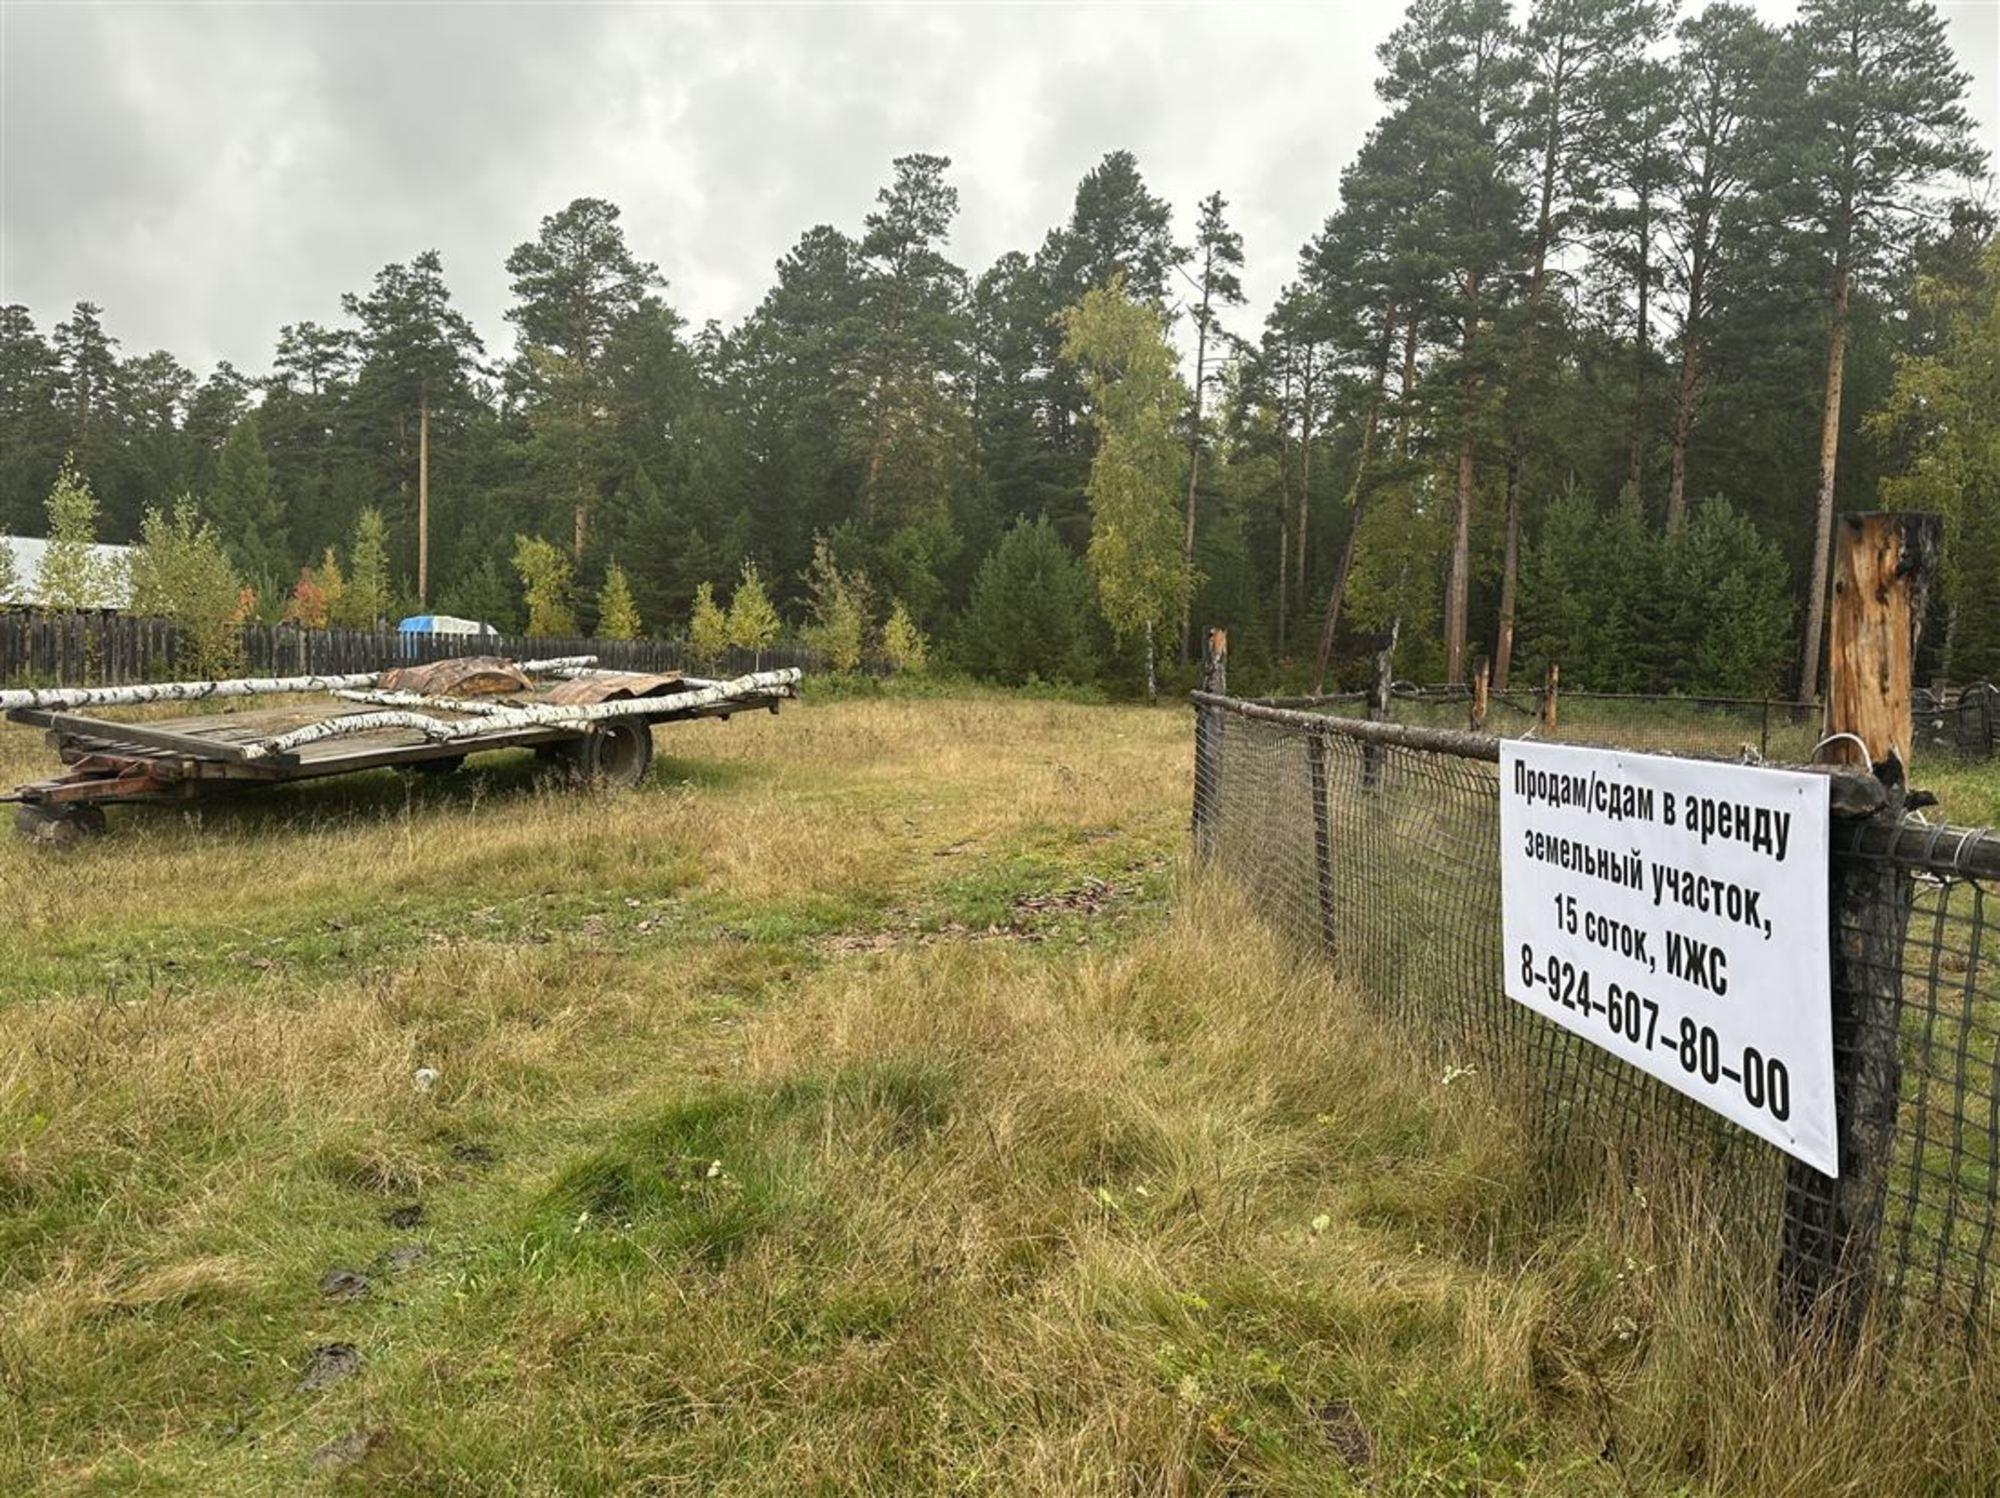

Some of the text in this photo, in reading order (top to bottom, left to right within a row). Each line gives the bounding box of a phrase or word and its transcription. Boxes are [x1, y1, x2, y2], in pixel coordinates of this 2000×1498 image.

[1514, 758, 1791, 862] Продам/сдам в аренду
[1524, 829, 1773, 940] земельный участок,
[1554, 893, 1727, 997] 15 соток, ИЖС
[1521, 943, 1790, 1122] 8-924-607-80-00
